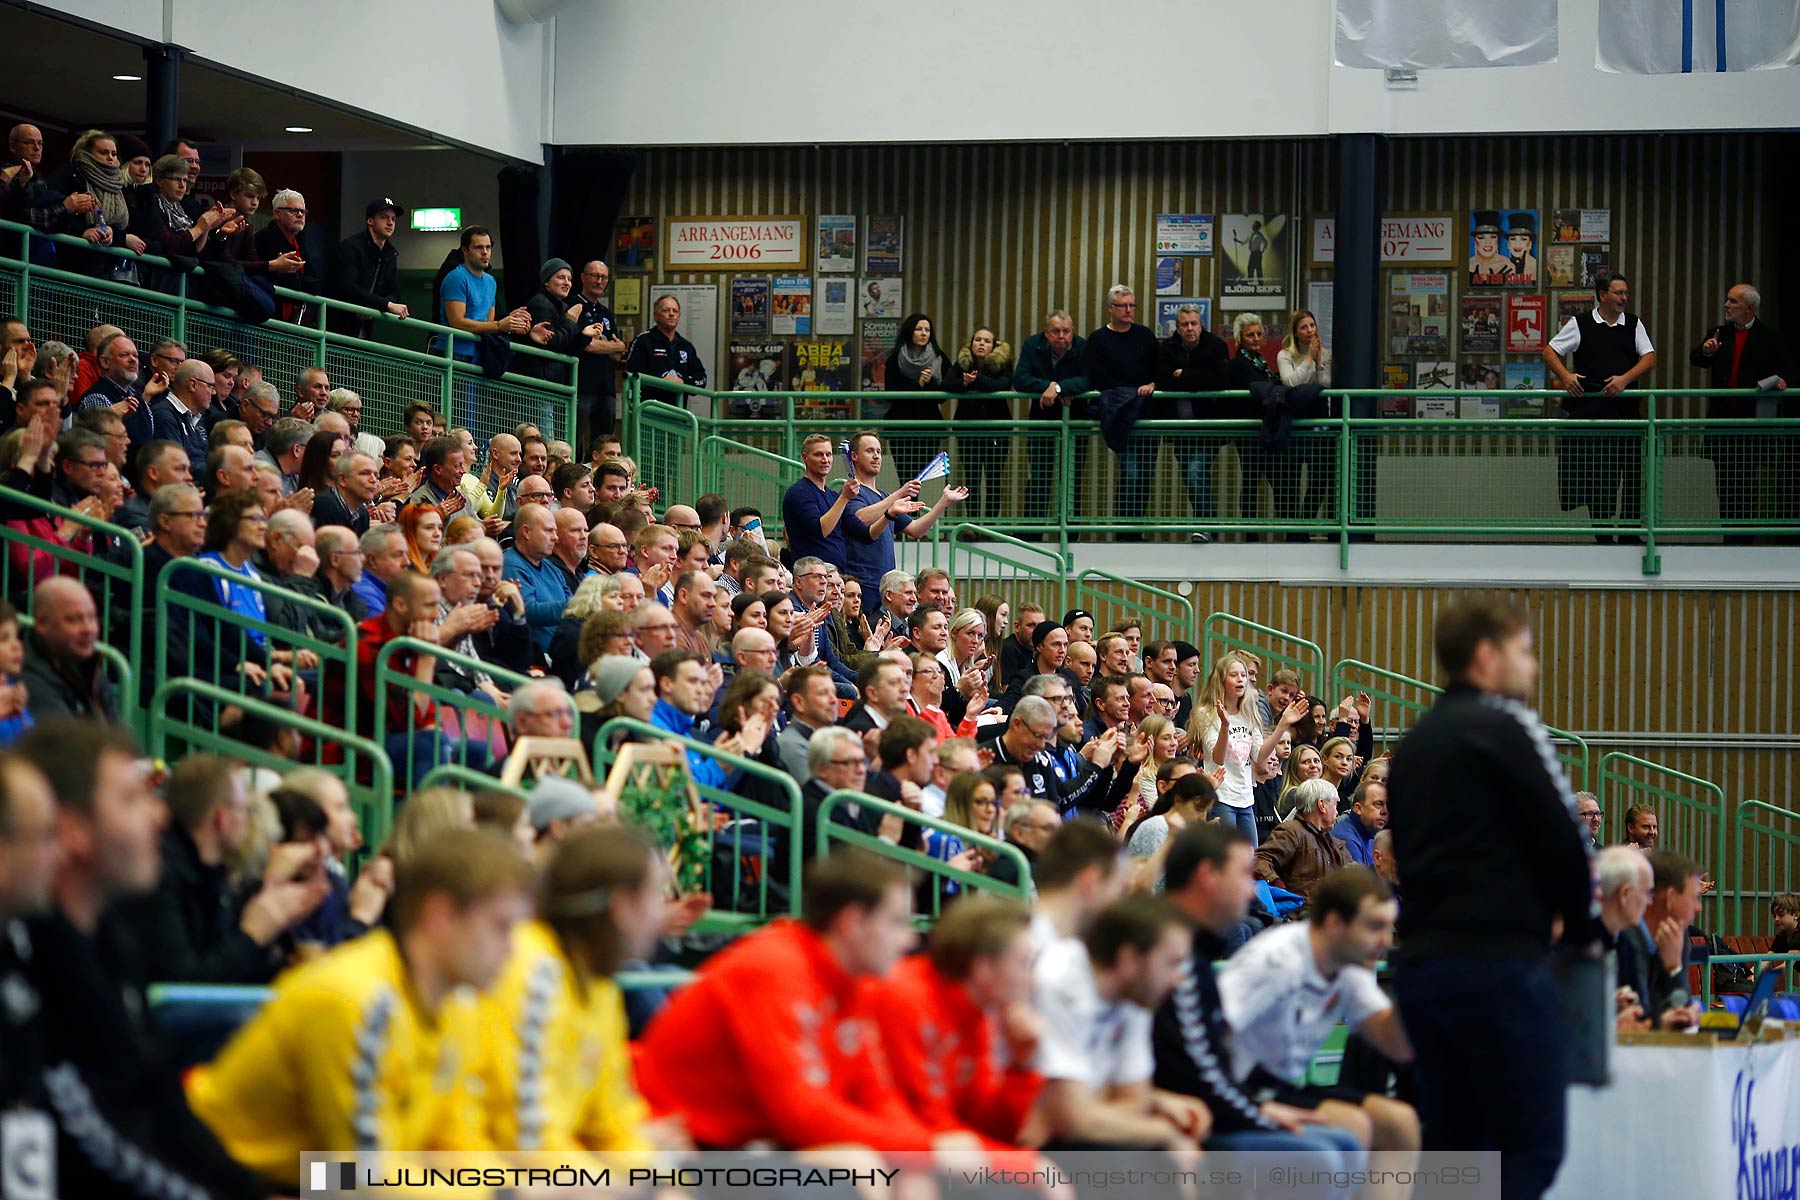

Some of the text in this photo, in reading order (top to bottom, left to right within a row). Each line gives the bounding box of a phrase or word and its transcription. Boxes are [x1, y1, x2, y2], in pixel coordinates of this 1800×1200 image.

[677, 225, 794, 242] ARRANGEMANG
[1321, 223, 1444, 239] AGEMANG
[709, 243, 762, 260] 2006
[1383, 241, 1409, 257] 07
[1472, 273, 1533, 284] AFTER DARK
[1224, 284, 1282, 293] BJÖRN SKIFS
[730, 345, 784, 353] VIKING CUP
[796, 344, 844, 357] ABBA
